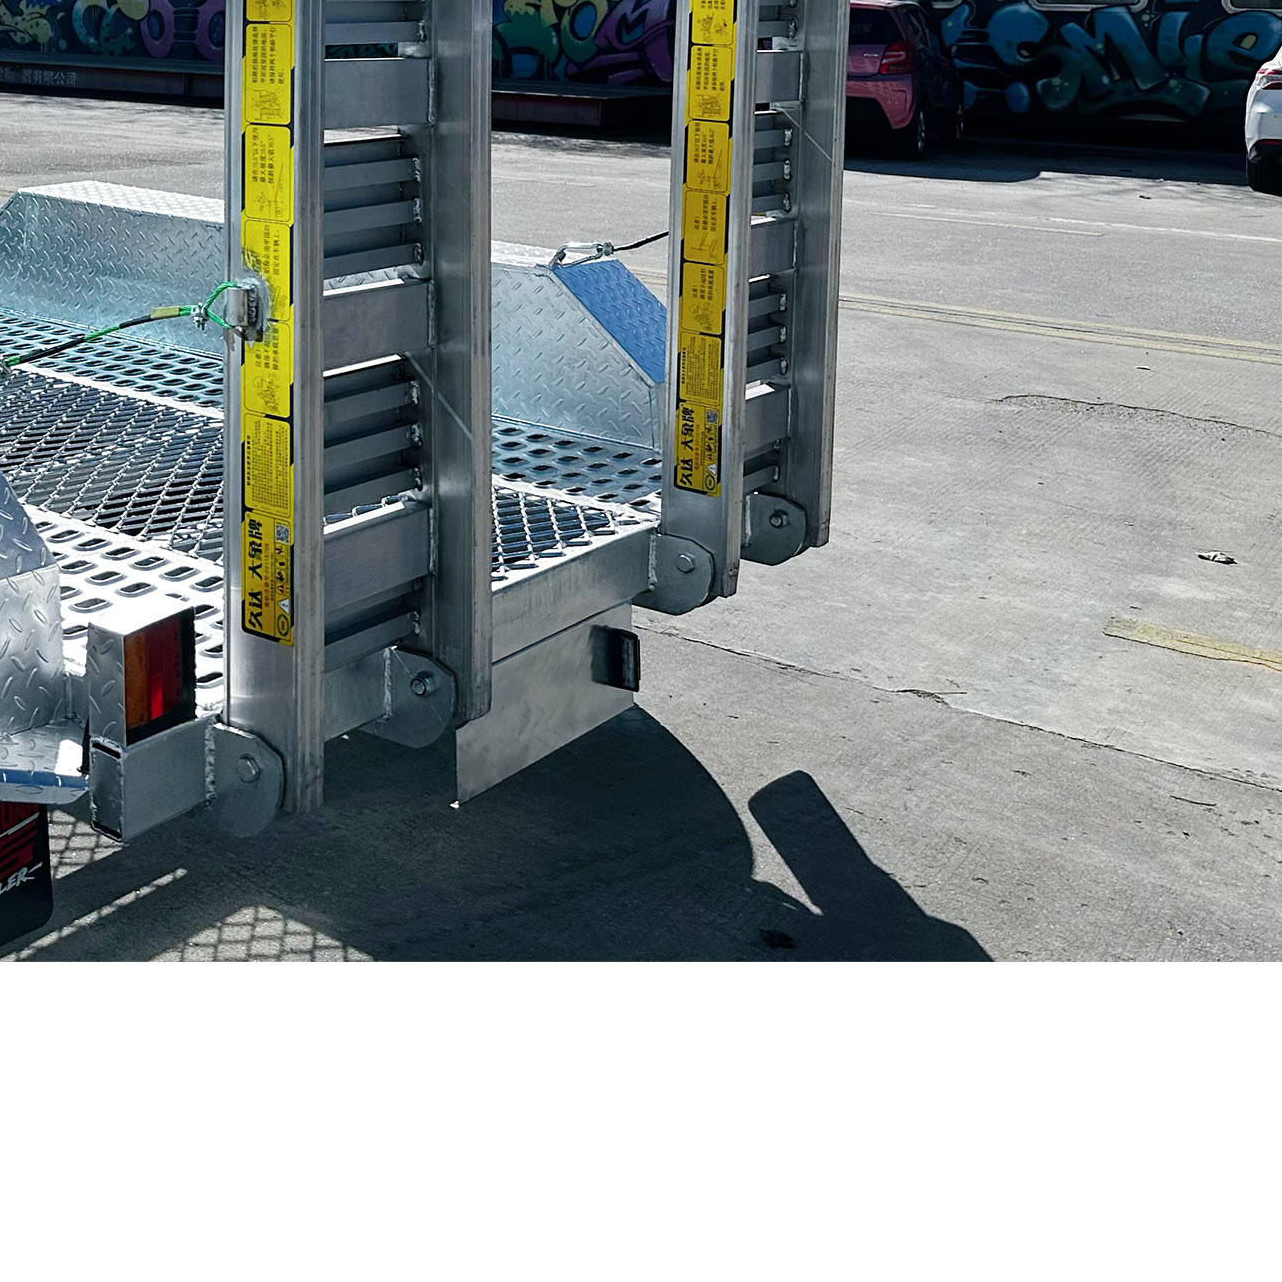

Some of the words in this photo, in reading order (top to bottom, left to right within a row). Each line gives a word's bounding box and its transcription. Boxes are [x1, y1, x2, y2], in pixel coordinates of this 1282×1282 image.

[248, 519, 262, 581] 大象牌
[248, 589, 262, 630] 久达
